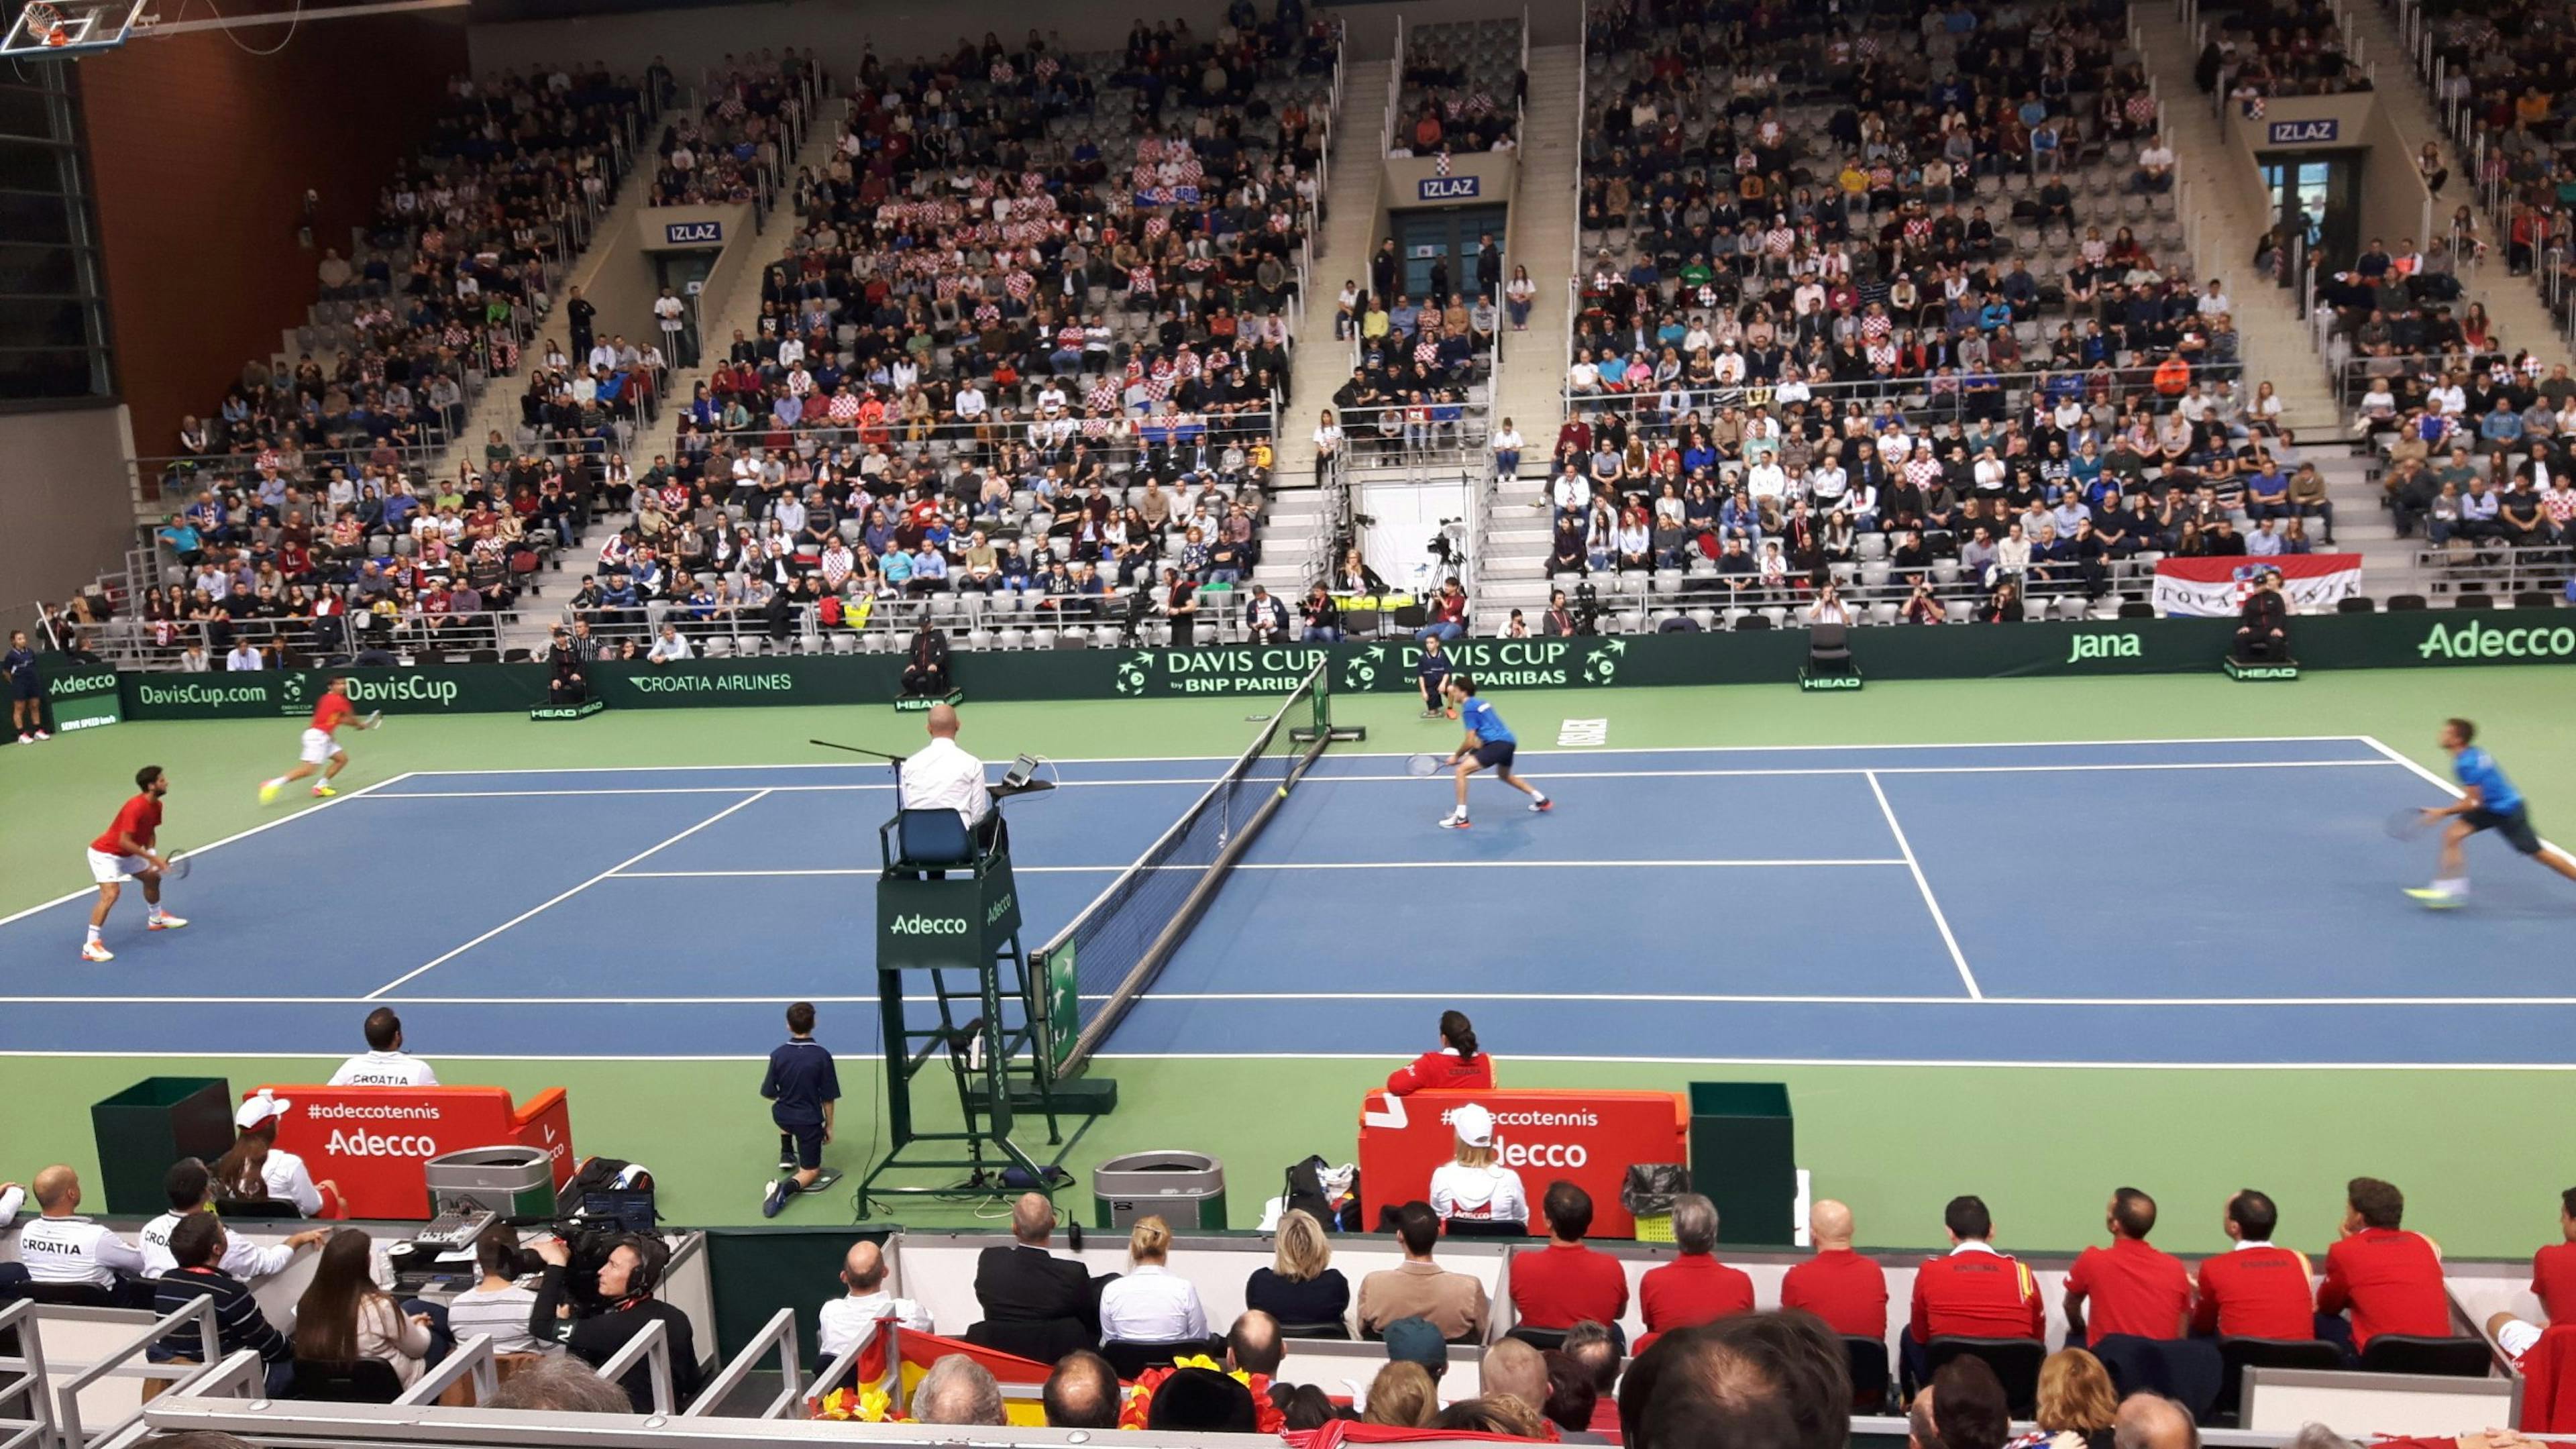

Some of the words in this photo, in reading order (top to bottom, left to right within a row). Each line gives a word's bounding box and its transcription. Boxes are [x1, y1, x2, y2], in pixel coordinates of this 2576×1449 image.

[2275, 121, 2331, 141] IZLAZ
[1424, 179, 1474, 197] IZLAZ
[672, 225, 716, 241] IZLAZ
[2159, 581, 2357, 608] TOVANIK
[2067, 632, 2141, 663] Jana
[2418, 620, 2575, 659] Adecco
[1168, 650, 1254, 674] DAVIS
[1262, 649, 1326, 672] CUP
[1402, 645, 1491, 668] DVIS
[1499, 643, 1566, 665] CUP
[639, 676, 713, 692] CROATIA
[716, 673, 792, 691] AIRLINES
[1472, 669, 1566, 686] PARIBAS
[1804, 677, 1860, 688] HEAD
[2238, 668, 2297, 679] HEAD
[49, 673, 116, 696] Adecco
[345, 675, 458, 706] DavisCup
[1171, 681, 1183, 690] by
[1185, 678, 1230, 692] BNP
[140, 684, 266, 708] DavisCup.com
[531, 708, 577, 718] HEAD
[987, 893, 1012, 926] Adecco
[890, 913, 967, 935] Adecco
[987, 967, 1005, 1100] adecco.com
[354, 1074, 409, 1085] CROATIA
[307, 1102, 441, 1120] #adeccotennis
[1440, 1108, 1599, 1127] #eccotennis
[325, 1127, 436, 1157] Adecco
[1491, 1135, 1588, 1168] decco
[22, 1238, 81, 1255] CROATIA
